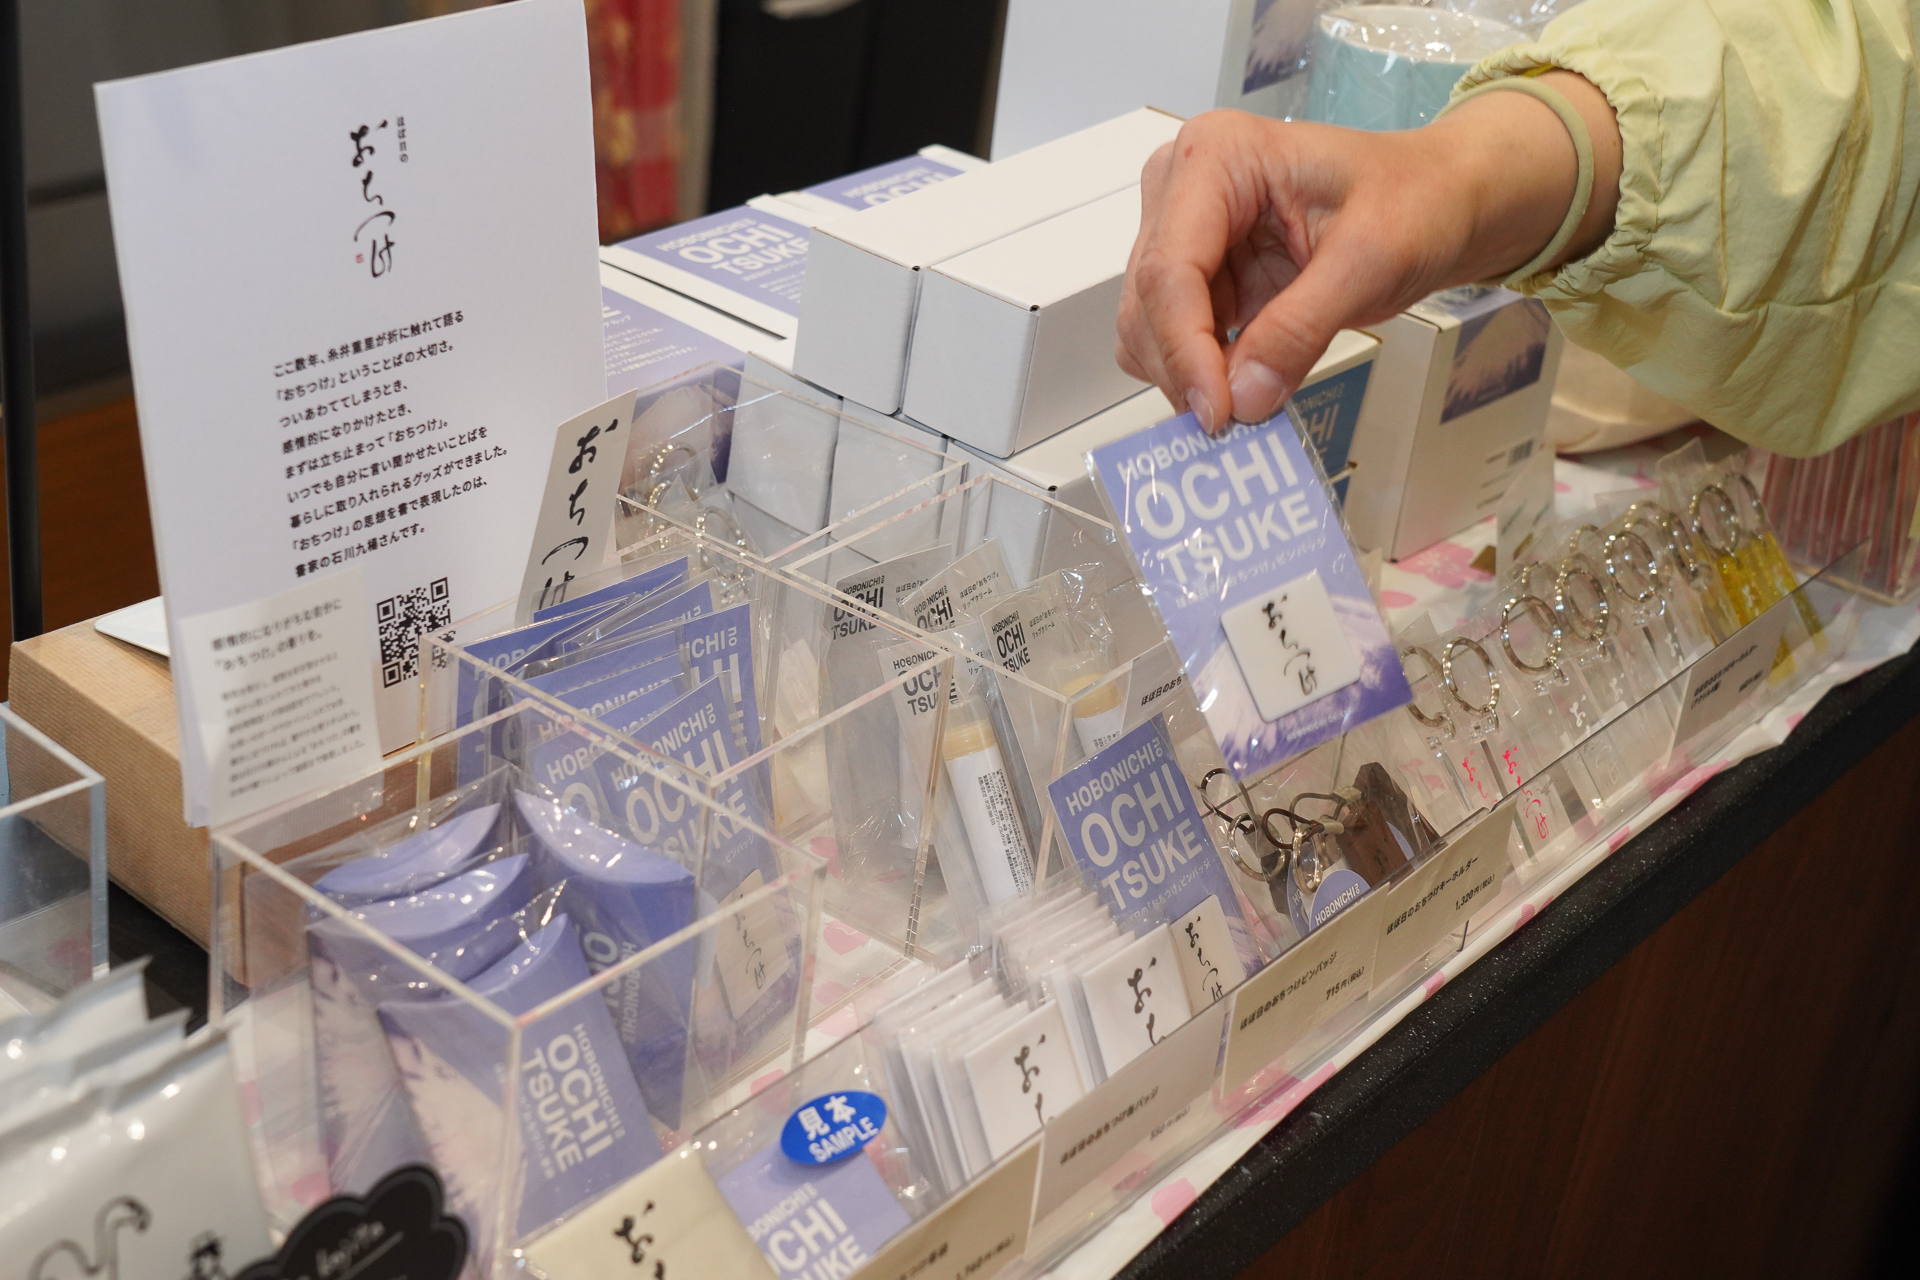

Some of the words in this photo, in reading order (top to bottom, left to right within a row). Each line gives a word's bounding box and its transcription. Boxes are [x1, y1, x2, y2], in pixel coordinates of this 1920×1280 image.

[397, 117, 408, 163] ほぼ日の
[350, 119, 396, 278] おちつけ
[679, 223, 795, 264] OCHI
[274, 310, 464, 378] ここ数年、糸井重里が折に触れて語る
[279, 380, 408, 428] ついあわててしまうとき、
[282, 403, 413, 455] 感情的になりかけたとき、
[287, 426, 488, 504] いつでも自分に言い聞かせたいことばを
[290, 446, 508, 529] 暮らしに取り入れられるグッズができました。
[1135, 432, 1299, 540] OCHI
[539, 418, 618, 611] おちつけ
[1156, 489, 1319, 586] TSUKE
[996, 622, 1026, 659] OCHI
[1003, 647, 1031, 679] TSUKE
[625, 729, 740, 839] OCHI
[1065, 743, 1156, 817] HOBONICHI
[1081, 763, 1186, 868] OCHI
[1101, 819, 1203, 911] TSUKE
[1386, 857, 1479, 935] ほぼ日のおちつけキーホルダー
[1315, 886, 1355, 926] HOBONICHI
[1240, 951, 1338, 1031] ほぼ日のおちつけピンバッジ
[521, 1047, 585, 1173] TSUKE
[547, 1033, 615, 1160] OCHI
[573, 1022, 622, 1129] HOBONICHI
[798, 1095, 857, 1141] 見本
[808, 1116, 879, 1163] SAMPLE
[768, 1197, 848, 1272] CHI
